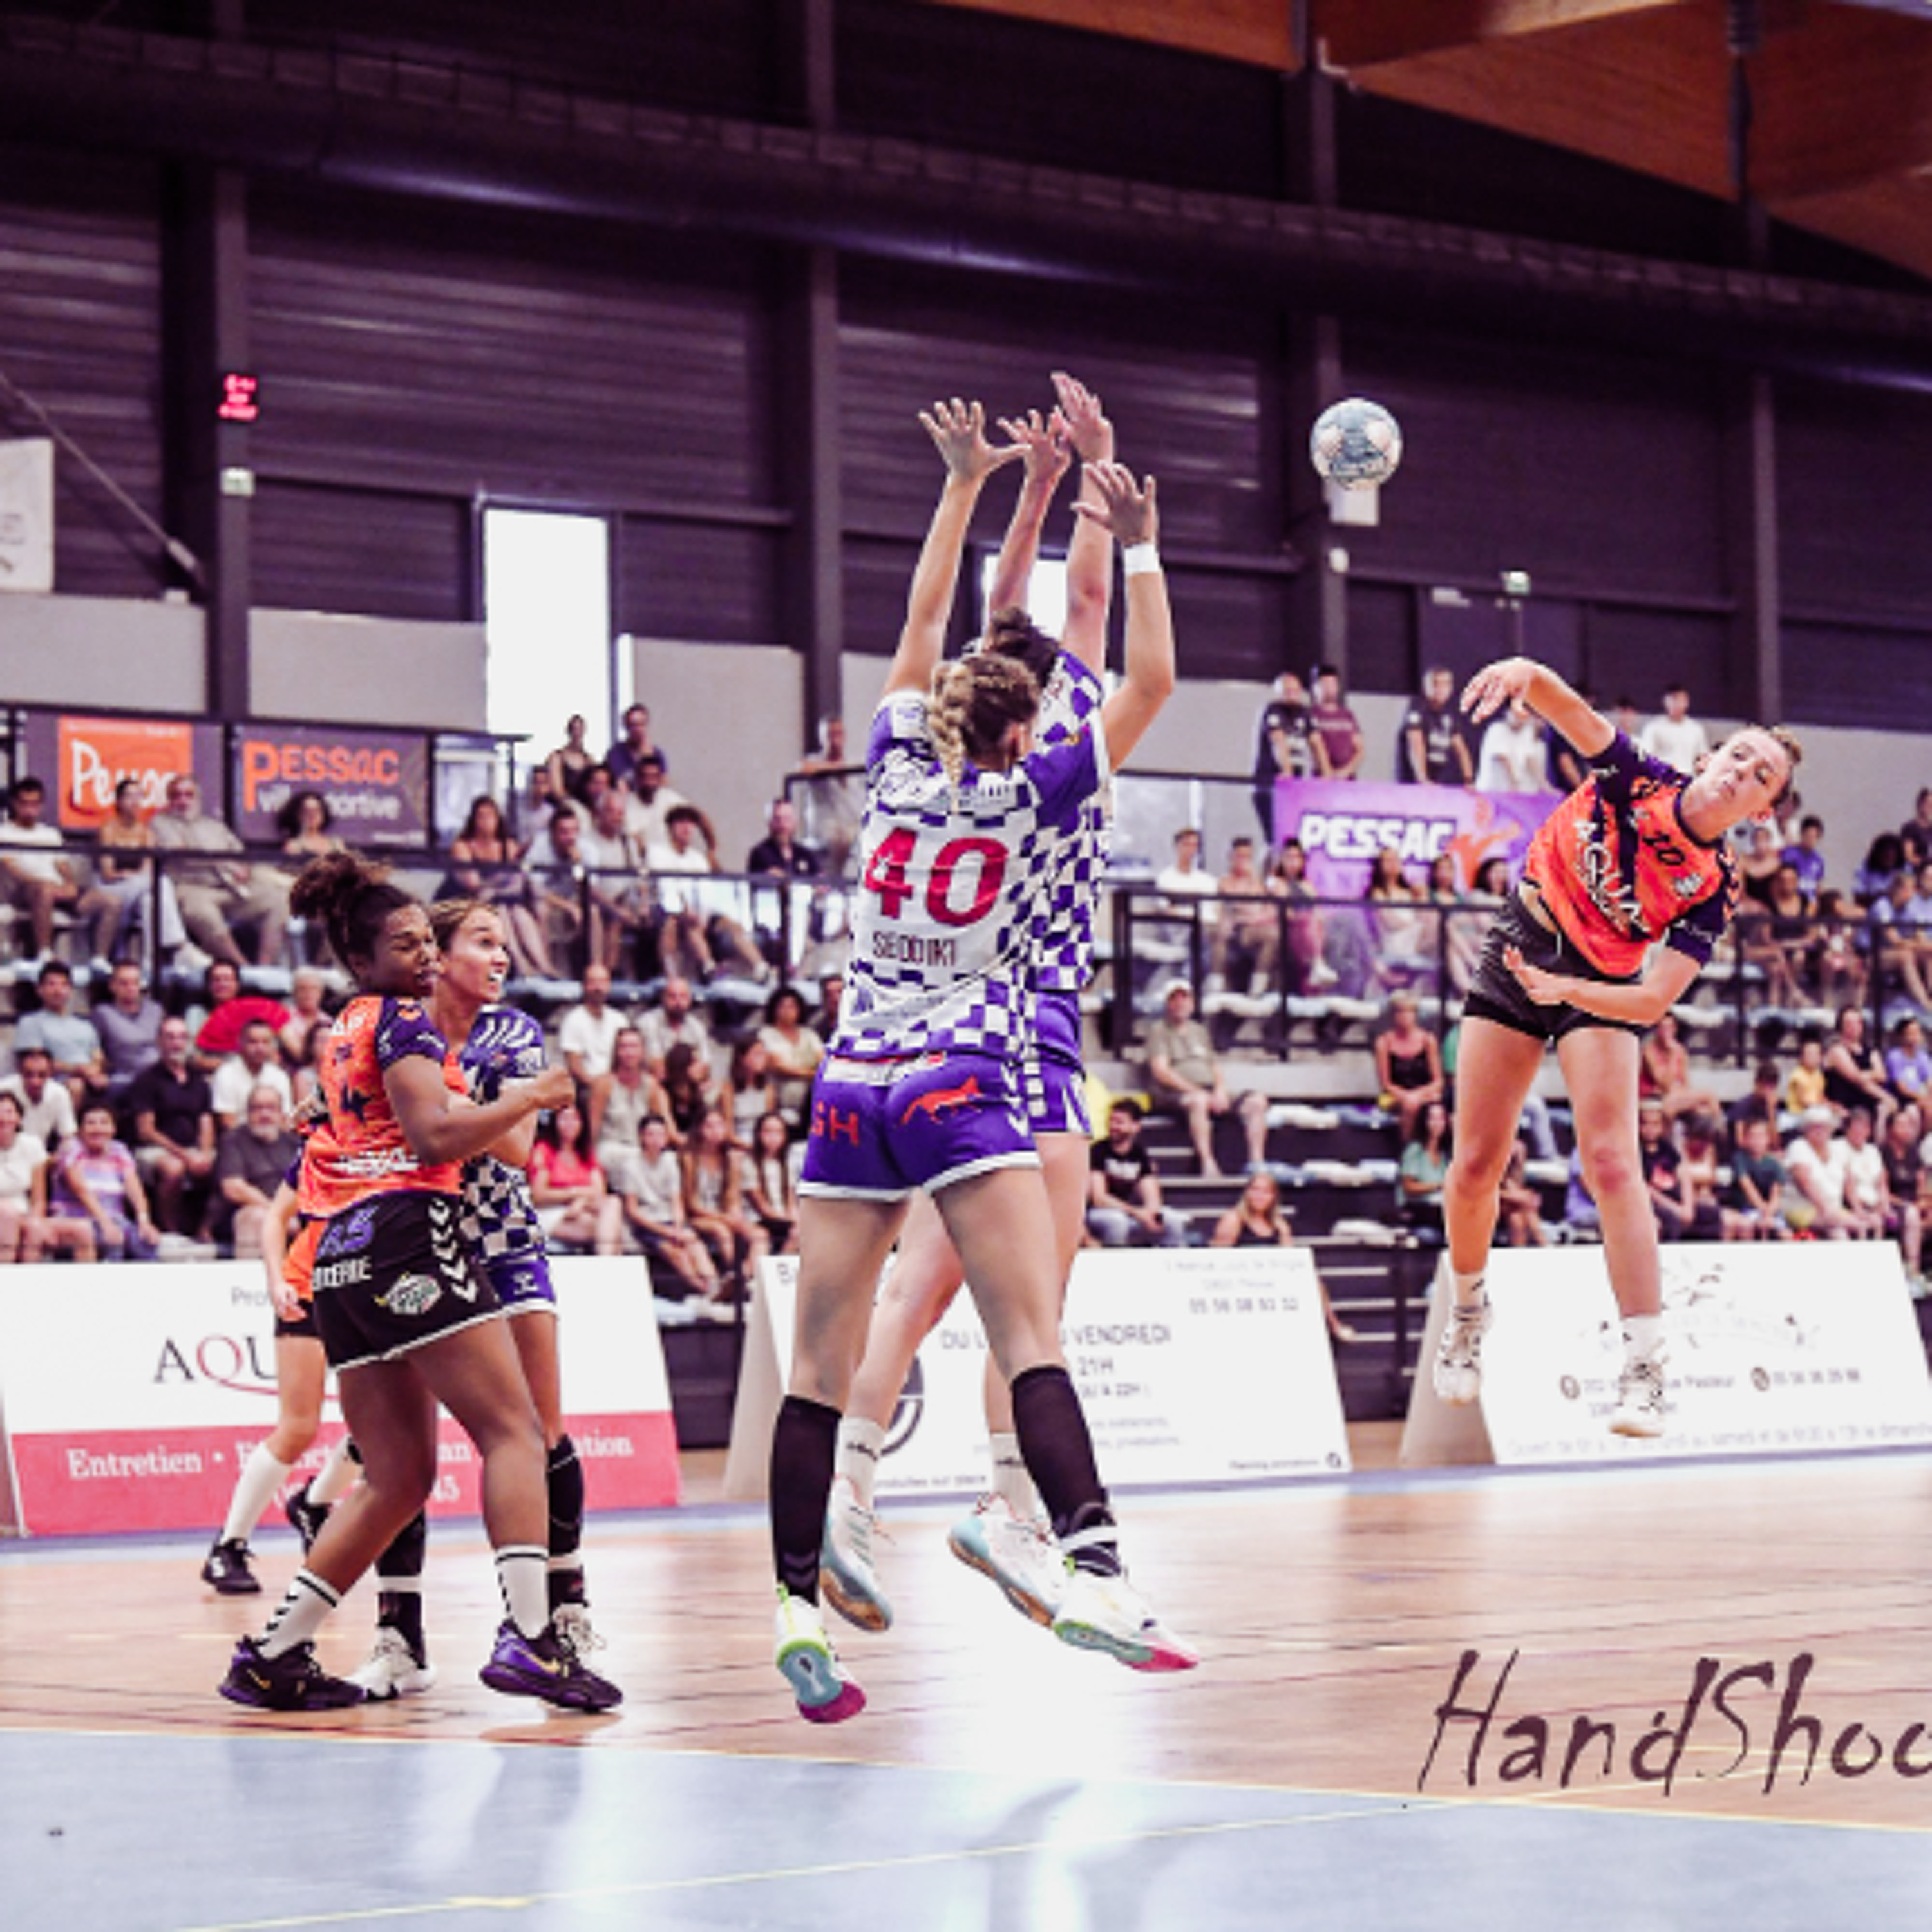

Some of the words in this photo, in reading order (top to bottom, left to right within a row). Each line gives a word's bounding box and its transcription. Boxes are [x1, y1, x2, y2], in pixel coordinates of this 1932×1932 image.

[243, 740, 399, 813] PESSAC
[1301, 814, 1454, 860] PESSAC
[864, 826, 1009, 927] 40
[1072, 1323, 1171, 1346] VENDREDI
[66, 1445, 202, 1479] Entretien
